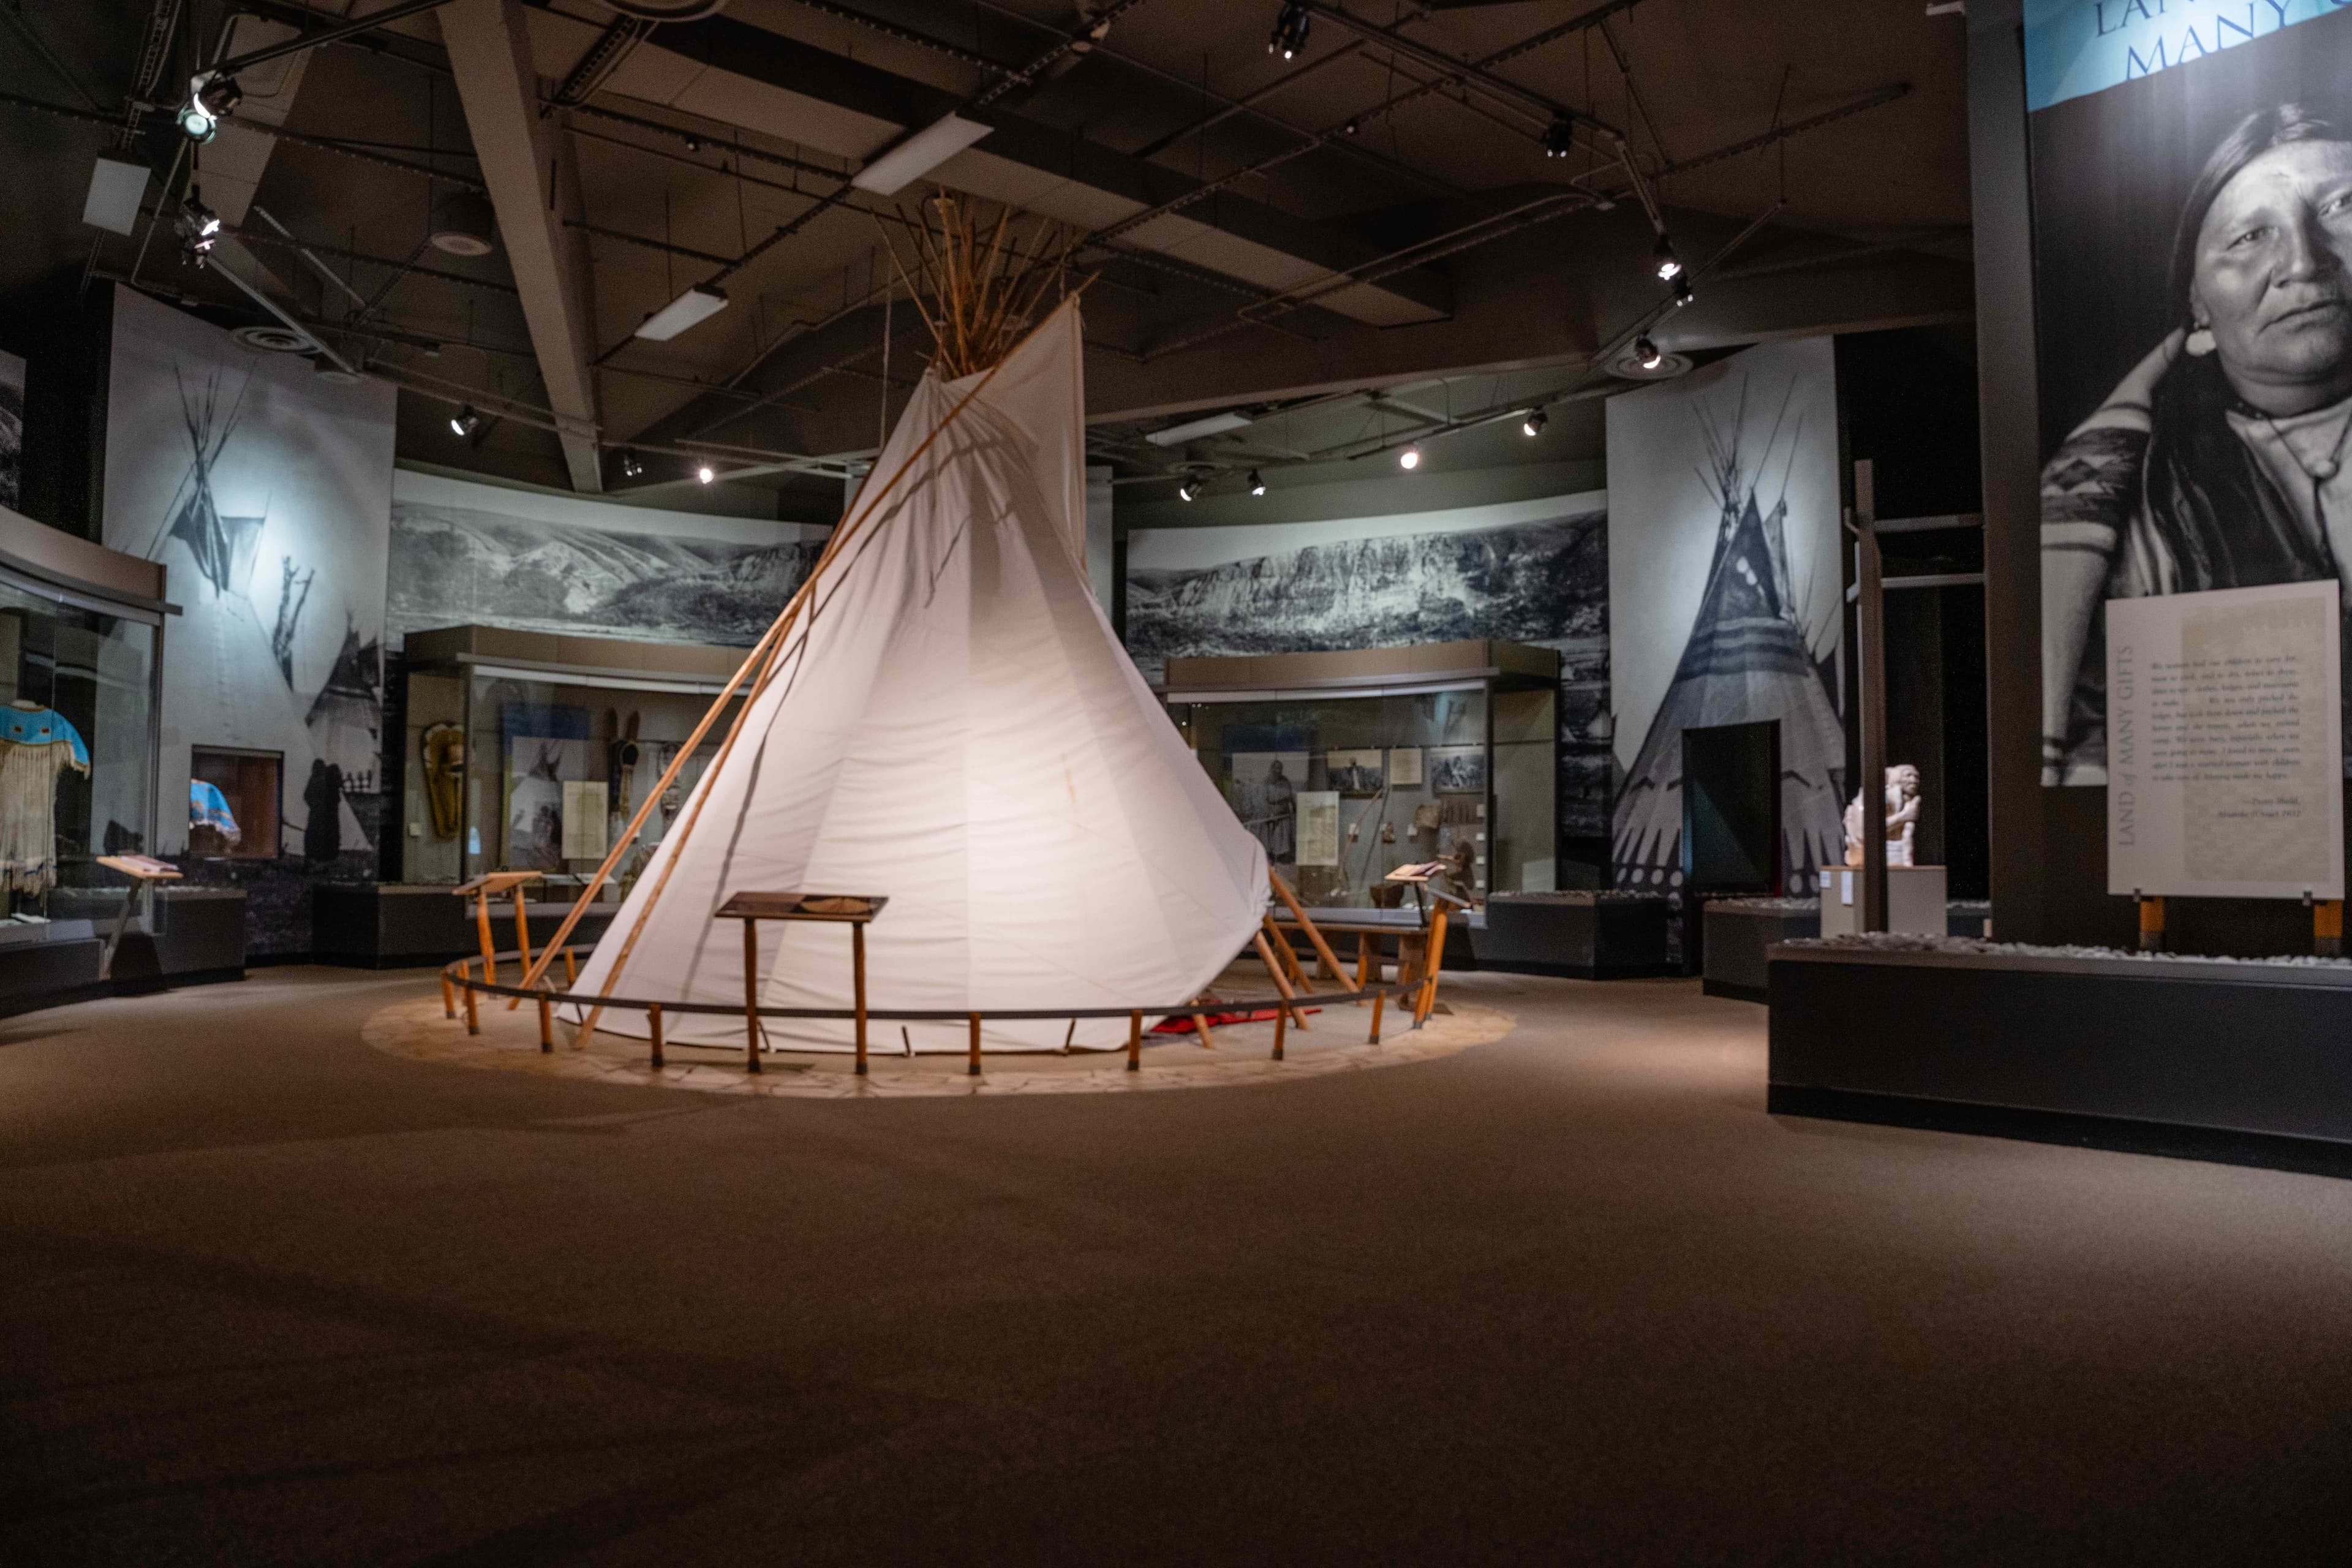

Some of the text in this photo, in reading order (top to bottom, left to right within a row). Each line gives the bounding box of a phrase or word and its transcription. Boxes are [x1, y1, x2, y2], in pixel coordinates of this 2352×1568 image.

[2127, 0, 2292, 80] MANY
[2116, 646, 2133, 701] GIFTS
[2117, 706, 2134, 765] MANY
[2117, 790, 2135, 846] LAND
